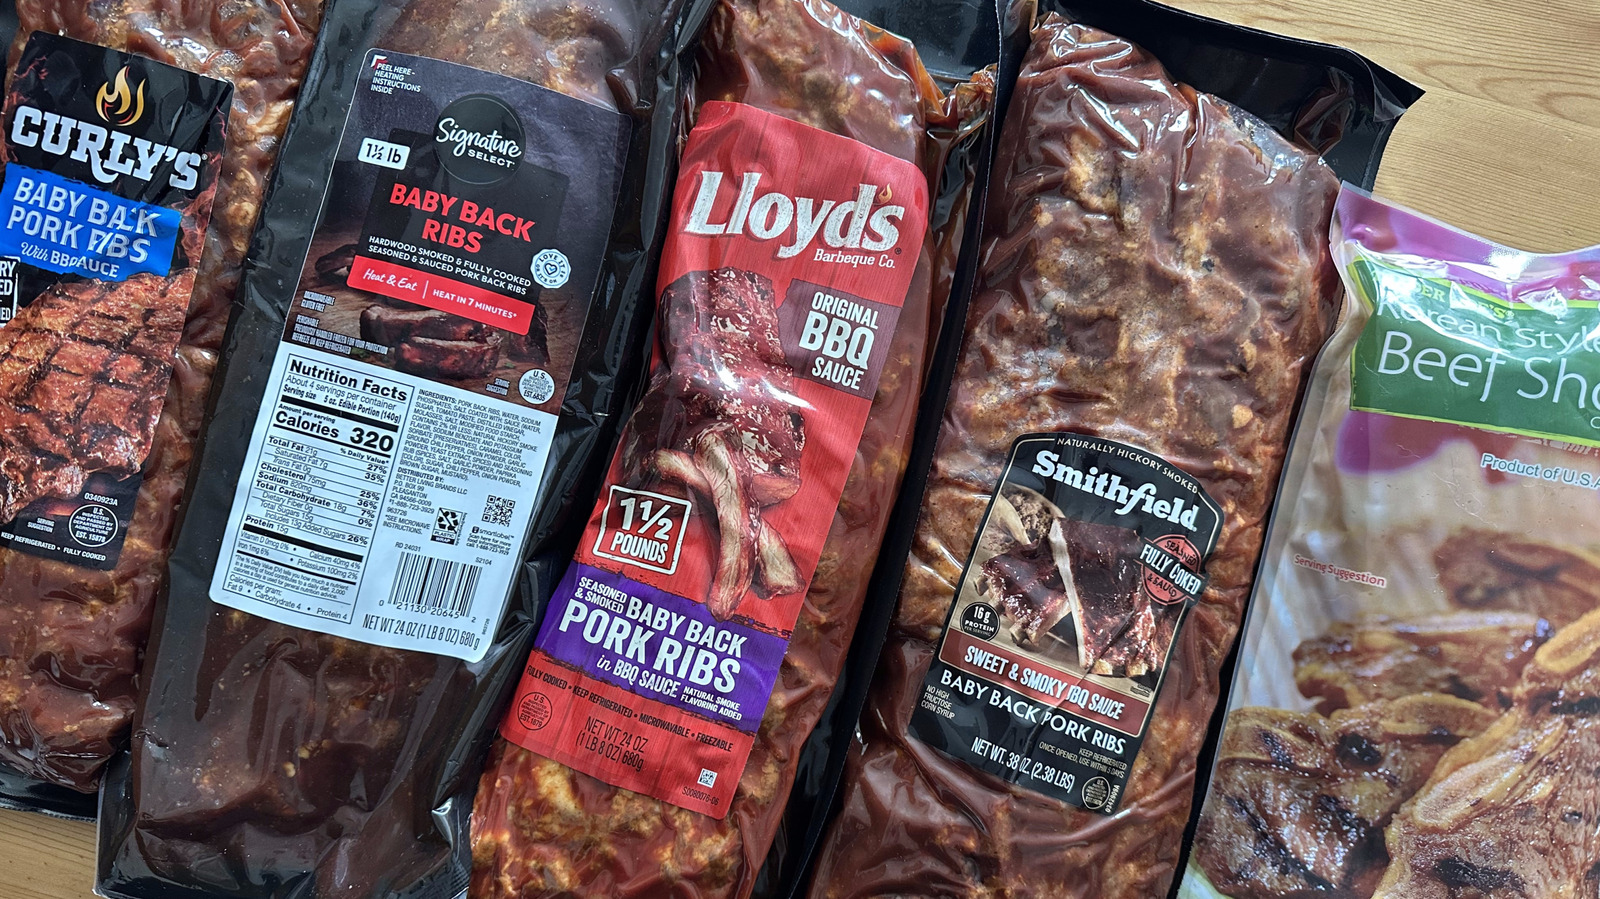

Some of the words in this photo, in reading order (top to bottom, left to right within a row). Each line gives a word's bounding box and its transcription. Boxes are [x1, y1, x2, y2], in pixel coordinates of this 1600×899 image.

[372, 77, 421, 92] INSTRUCTIONS
[375, 70, 404, 81] HEATING
[376, 63, 393, 72] PEEL
[371, 84, 393, 95] INSIDE
[11, 106, 200, 191] CURLY'S
[387, 145, 402, 163] lb
[435, 117, 522, 158] Signature
[468, 149, 515, 169] SELECT
[14, 177, 87, 218] BABY
[390, 183, 458, 216] BABY
[460, 200, 536, 243] BACK
[7, 206, 90, 250] PORK
[422, 218, 483, 253] RIBS
[21, 242, 49, 262] With
[369, 235, 416, 254] HARDWOOD
[418, 248, 454, 263] SMOKED
[456, 257, 462, 265] &
[463, 260, 492, 276] FULLY
[494, 267, 531, 287] COOKED
[814, 249, 875, 268] Barbeque
[879, 254, 895, 268] Co.
[363, 268, 385, 283] Heat
[386, 274, 397, 285] &
[397, 278, 418, 292] Eat
[368, 245, 410, 261] SEASONED
[411, 254, 418, 262] &
[419, 256, 454, 273] SAUCED
[455, 268, 480, 282] PORK
[482, 275, 505, 289] BACK
[507, 282, 527, 296] RIBS
[433, 289, 455, 300] HEAT
[456, 294, 467, 304] IN
[468, 298, 475, 307] 7
[812, 291, 878, 329] ORIGINAL
[799, 310, 874, 370] BBQ
[289, 359, 357, 388] Nutrition
[362, 379, 407, 401] Facts
[812, 357, 864, 390] SAUCE
[1377, 331, 1505, 403] Beef
[284, 384, 304, 398] Serving
[305, 390, 316, 399] size
[329, 397, 337, 405] oz.
[338, 398, 356, 410] Edible
[358, 404, 380, 416] Portion
[381, 409, 401, 424] (140g)
[286, 375, 307, 388] About
[316, 384, 345, 397] servings
[347, 392, 359, 400] per
[360, 395, 397, 410] container
[275, 411, 340, 438] Calories
[350, 427, 393, 452] 320
[1057, 437, 1115, 454] NATURALLY
[1117, 448, 1162, 471] HICKORY
[1162, 467, 1199, 495] SMOKED
[1481, 454, 1539, 476] Product
[1543, 468, 1559, 480] of
[1032, 449, 1199, 532] Smithfield
[1, 532, 14, 540] KEEP
[15, 536, 56, 550] REFRIGERATED
[64, 547, 81, 556] FULLY
[82, 552, 106, 561] COOKED
[610, 531, 668, 564] POUNDS
[1140, 544, 1173, 572] FULLY
[1294, 554, 1327, 574] Serving
[1328, 564, 1385, 586] Suggestion
[579, 577, 627, 603] SEASONED
[363, 614, 380, 630] NET
[380, 617, 394, 633] WT
[394, 621, 405, 635] 24
[406, 624, 419, 637] OZ
[426, 625, 438, 640] LB
[438, 627, 446, 640] 8
[445, 629, 460, 645] OZ)
[575, 588, 584, 598] &
[584, 593, 624, 614] SMOKED
[627, 596, 686, 636] BABY
[685, 619, 747, 657] BACK
[965, 620, 994, 632] PROTEIN
[558, 599, 655, 664] PORK
[653, 636, 741, 693] RIBS
[597, 655, 612, 671] in
[613, 660, 640, 684] BBQ
[639, 670, 681, 698] SAUCE
[926, 685, 936, 693] NO
[936, 688, 949, 699] HIGH
[964, 645, 1009, 675] SWEET
[1009, 664, 1019, 681] &
[1020, 668, 1067, 699] SMOKY
[1088, 690, 1126, 720] SAUCE
[527, 665, 543, 679] FULLY
[543, 673, 567, 689] COOKED
[573, 685, 589, 698] KEEP
[589, 693, 633, 718] REFRIGERATED
[639, 713, 691, 738] MICROWAVABLE
[696, 733, 733, 752] FREEZABLE
[680, 695, 718, 714] FLAVORING
[718, 706, 742, 721] ADDED
[683, 686, 715, 702] NATURAL
[716, 697, 741, 710] SMOKE
[921, 700, 936, 711] CORN
[936, 706, 955, 719] SYRUP
[924, 692, 952, 710] FRUCTOSE
[940, 670, 989, 699] BABY
[989, 689, 1037, 723] BACK
[1041, 711, 1093, 742] PORK
[1092, 732, 1127, 754] RIBS
[584, 716, 604, 733] NET
[604, 723, 620, 740] WT
[619, 731, 633, 747] 24
[633, 737, 648, 753] OZ
[584, 737, 598, 752] LB
[599, 744, 606, 755] 8
[606, 745, 622, 763] OZ)
[971, 737, 991, 756] NET
[990, 744, 1005, 764] WT.
[1006, 753, 1019, 769] 38
[1019, 757, 1030, 774] OZ.
[1031, 760, 1056, 782] (2.38
[1054, 769, 1075, 794] LBS)
[1039, 742, 1056, 754] ONCE
[1056, 748, 1078, 763] OPENED,
[1079, 757, 1090, 766] USE
[1090, 761, 1106, 773] WITHIN
[1111, 769, 1125, 778] DAYS
[1079, 748, 1093, 757] KEEP
[1093, 753, 1127, 770] REFRIGERATED
